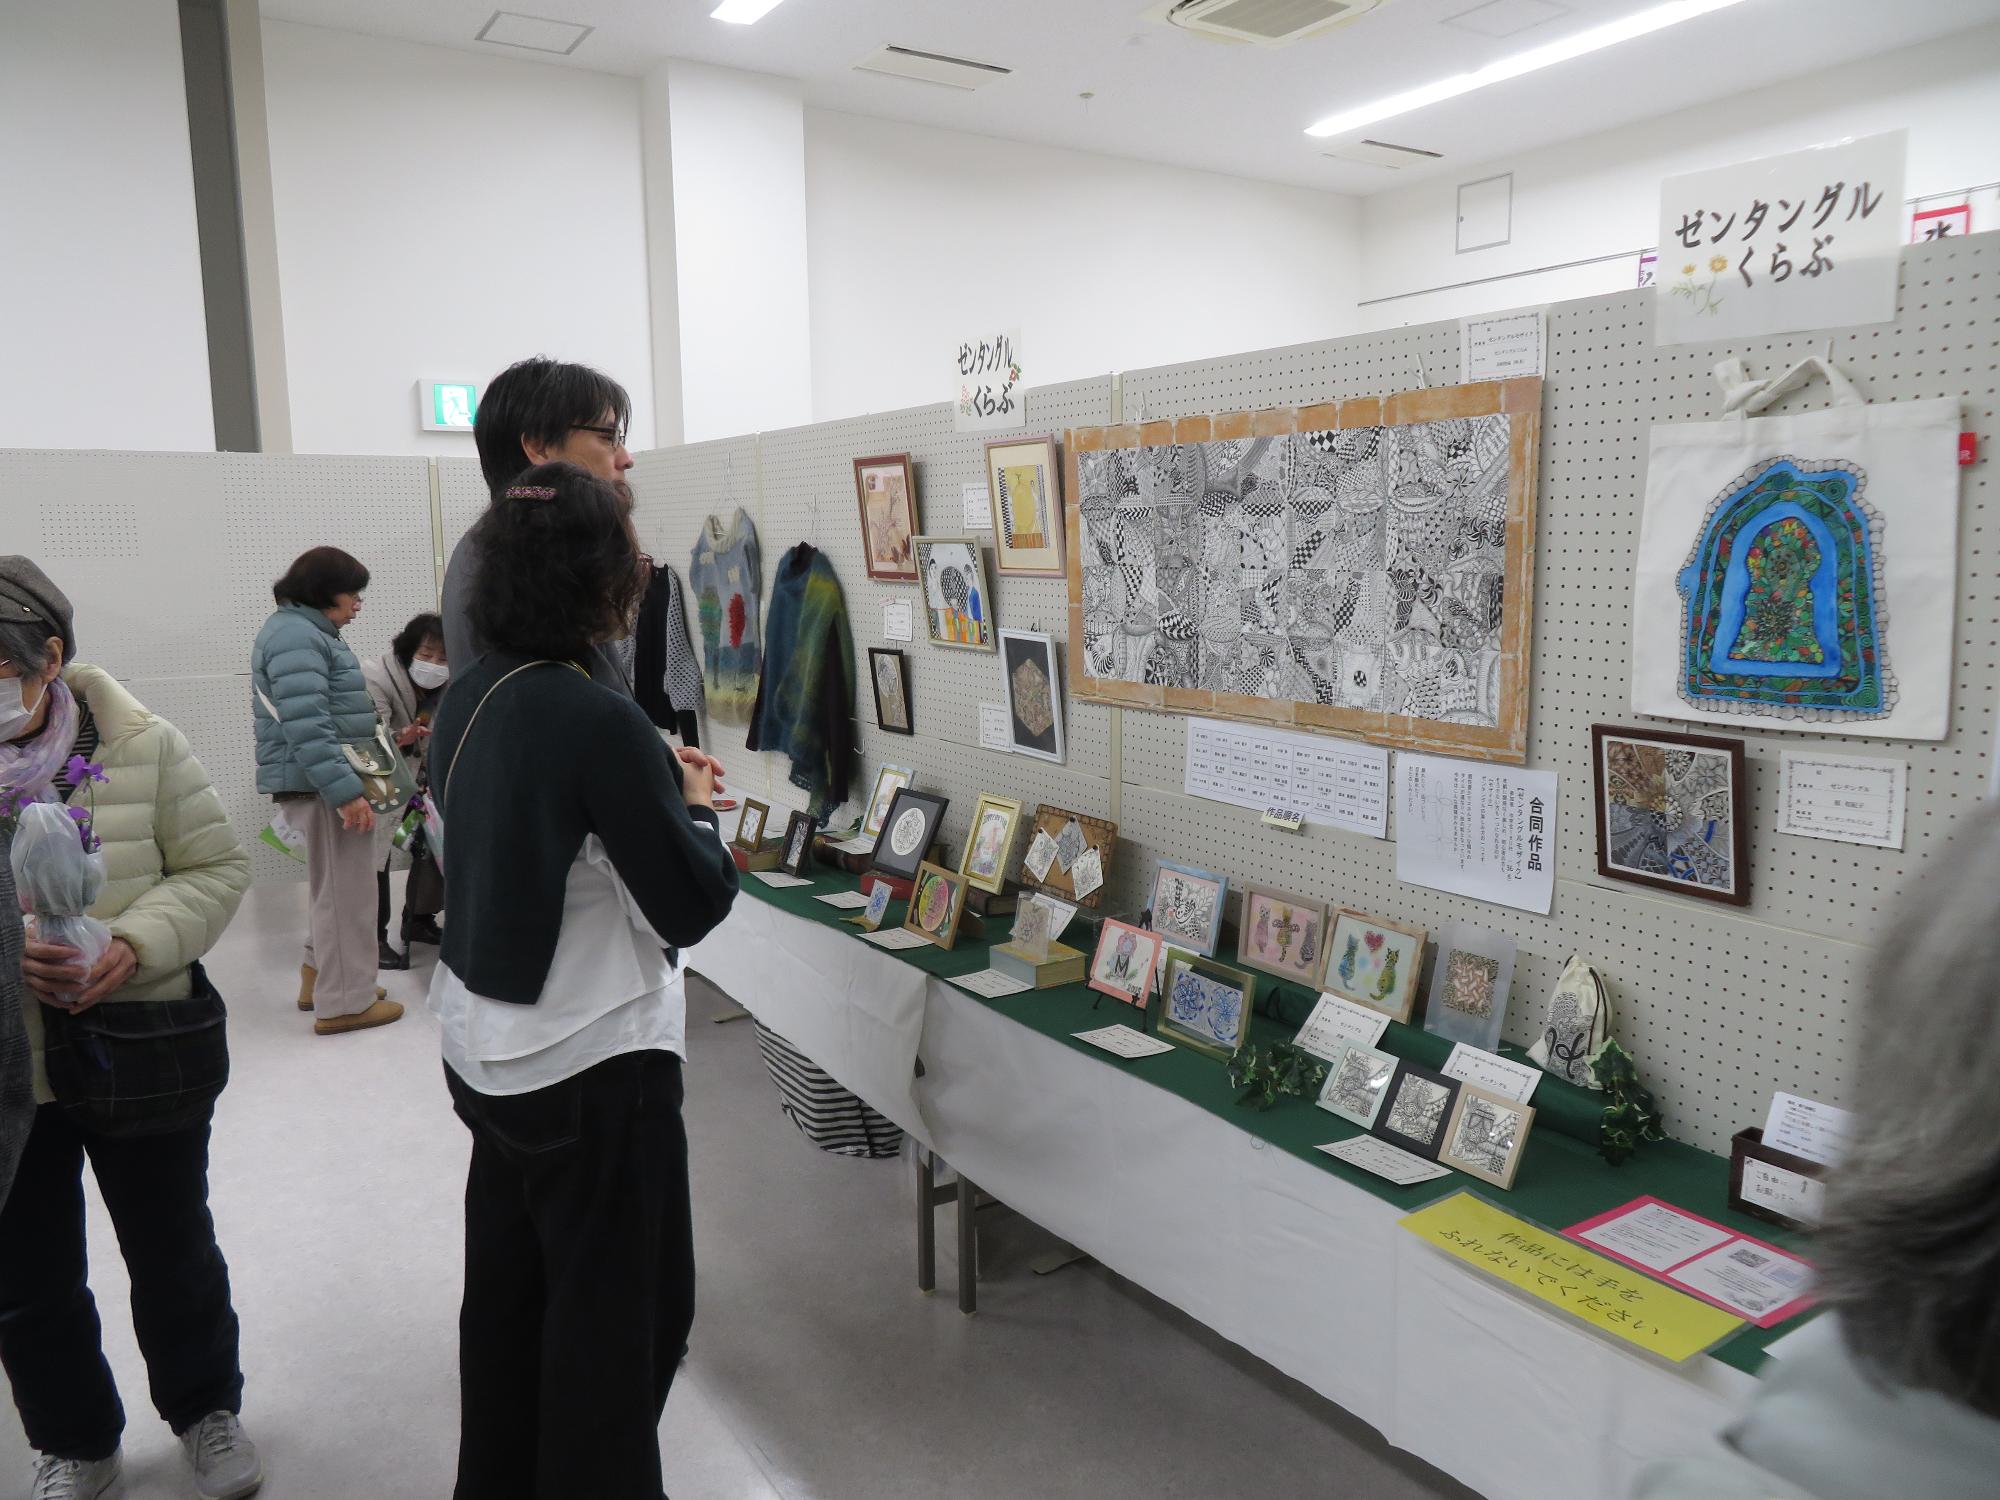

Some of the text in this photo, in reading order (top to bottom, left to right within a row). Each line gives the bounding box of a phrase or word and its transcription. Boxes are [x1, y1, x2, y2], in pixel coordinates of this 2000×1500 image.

[1674, 181, 1884, 249] ゼンタングル
[1737, 234, 1835, 288] くらぶ
[957, 334, 1014, 376] ゼンタングル
[973, 381, 1015, 418] くらぶ
[1265, 806, 1301, 823] 作品順名
[1527, 796, 1545, 872] 合同作品
[1438, 1229, 1661, 1336] ふれないでください
[1497, 1230, 1649, 1303] 作品には手を
